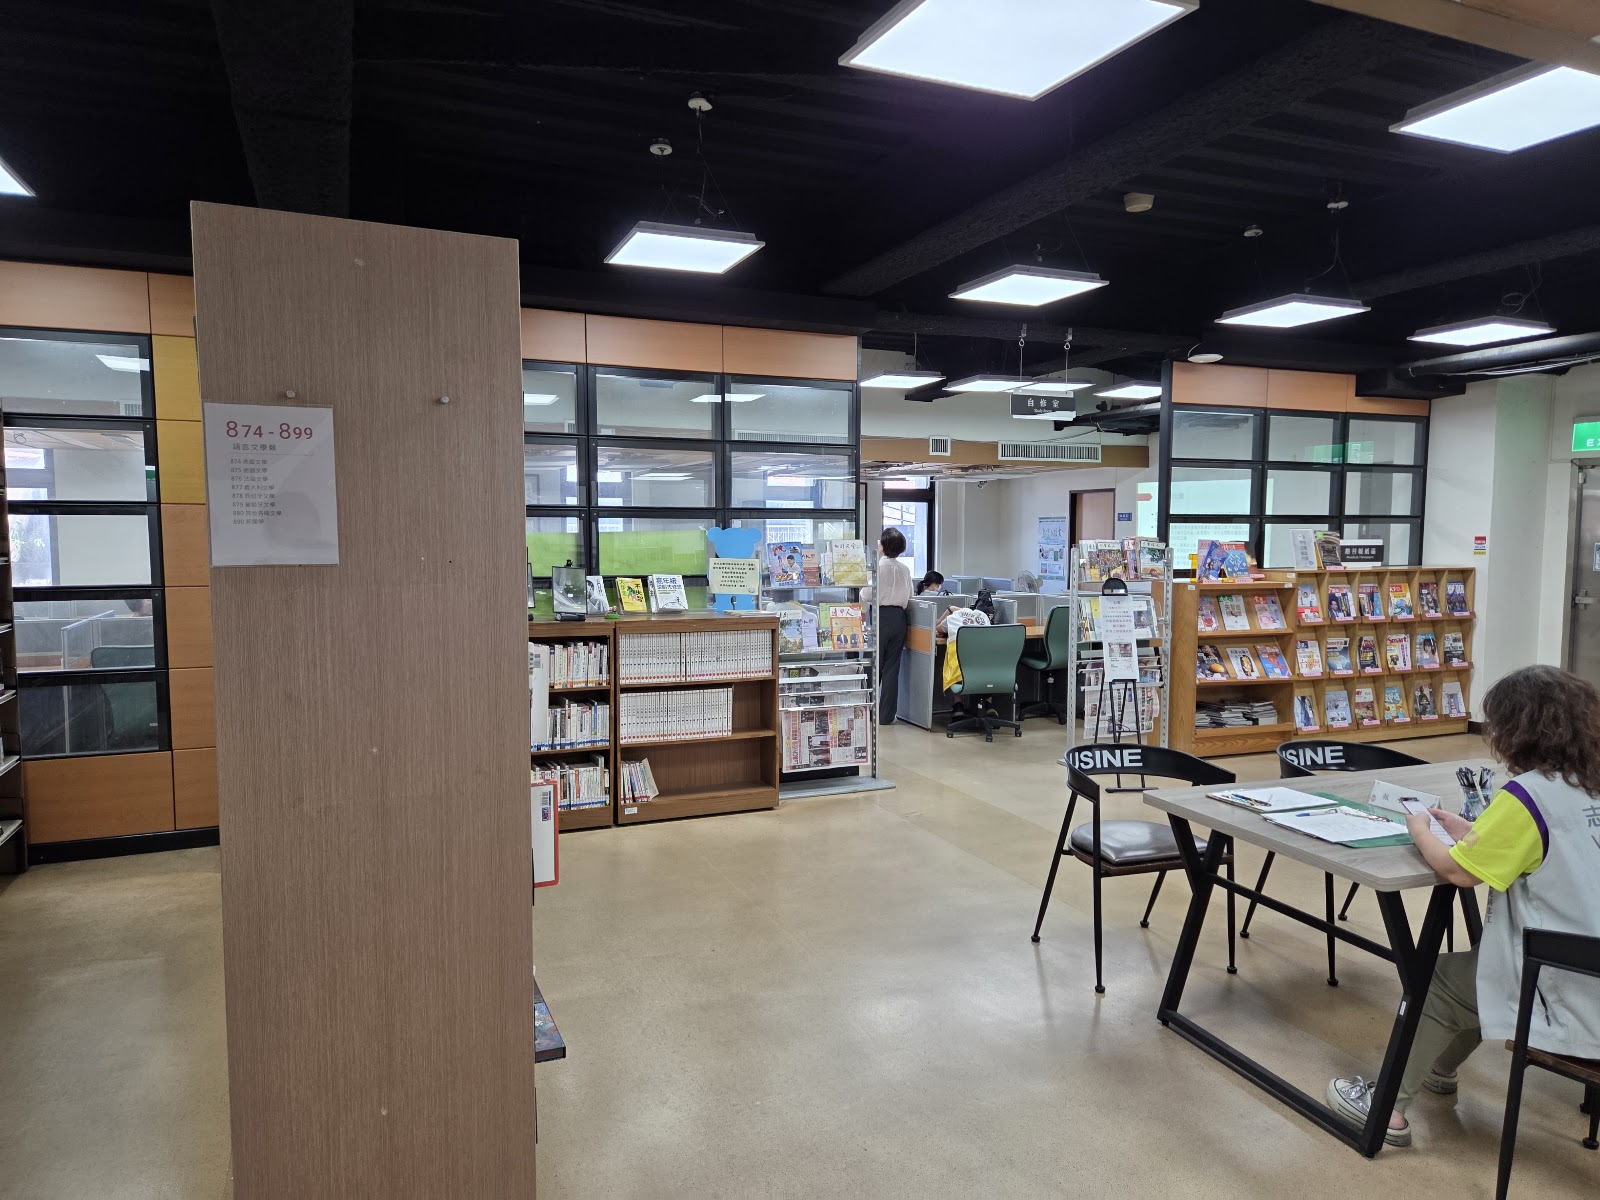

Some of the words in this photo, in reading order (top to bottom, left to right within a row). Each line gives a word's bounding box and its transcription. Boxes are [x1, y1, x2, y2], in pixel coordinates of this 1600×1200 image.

[1027, 398, 1060, 408] 自修室
[232, 442, 277, 451] 語言文學類
[1282, 745, 1345, 766] SINE
